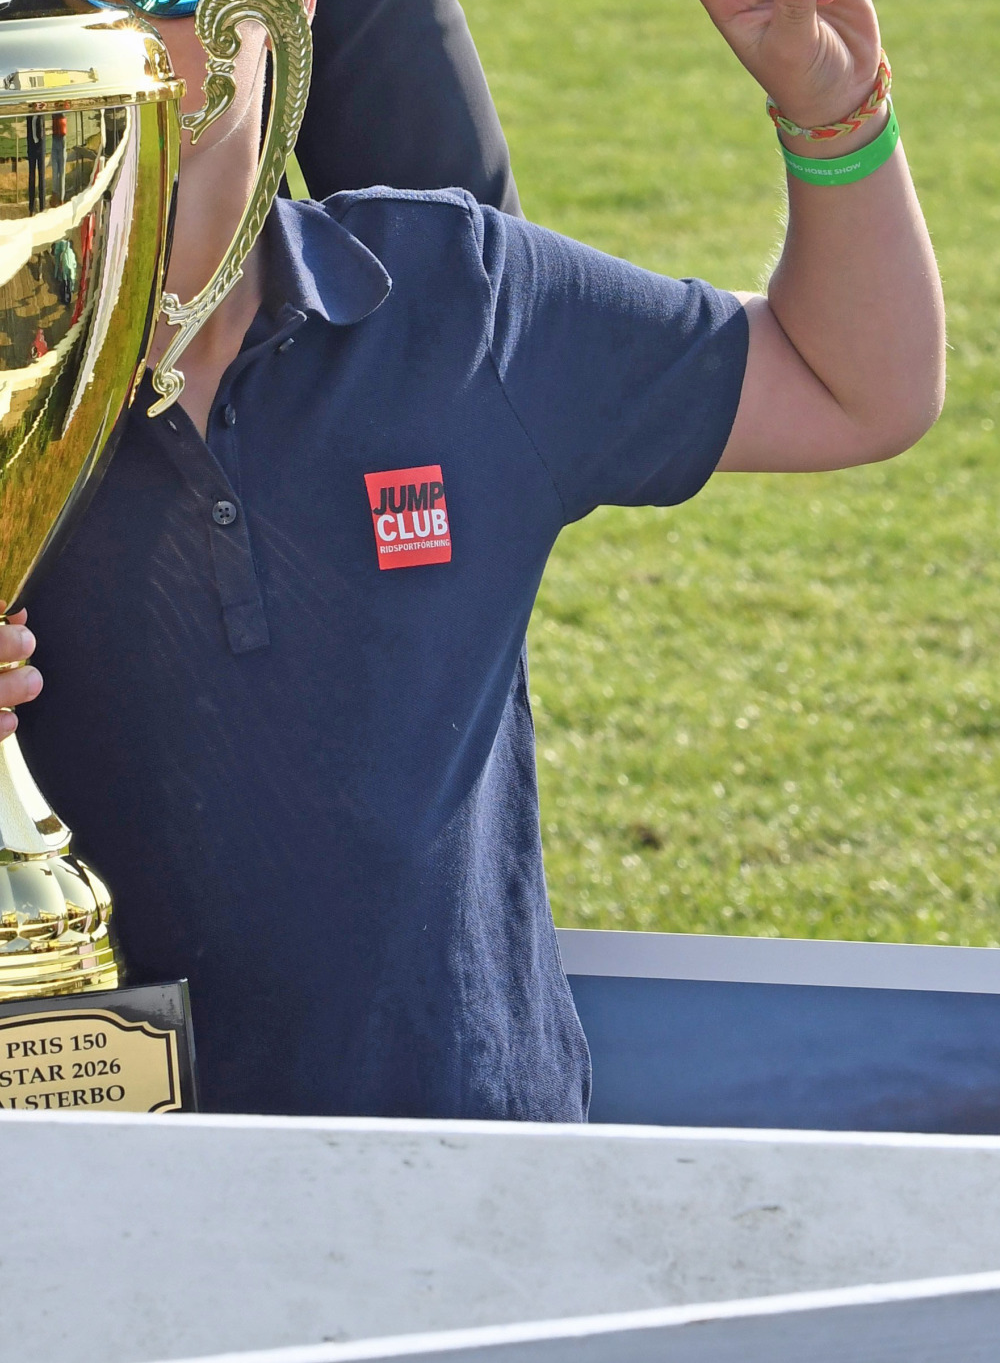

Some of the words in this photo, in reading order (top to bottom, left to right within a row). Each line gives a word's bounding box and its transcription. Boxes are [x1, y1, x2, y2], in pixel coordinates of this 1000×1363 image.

[804, 167, 833, 176] HORSE
[833, 161, 861, 175] SHOW
[373, 481, 444, 515] JUMP
[377, 508, 448, 542] CLUB
[6, 1036, 63, 1059] PRIS
[69, 1032, 107, 1052] 150
[71, 1057, 122, 1079] 2026
